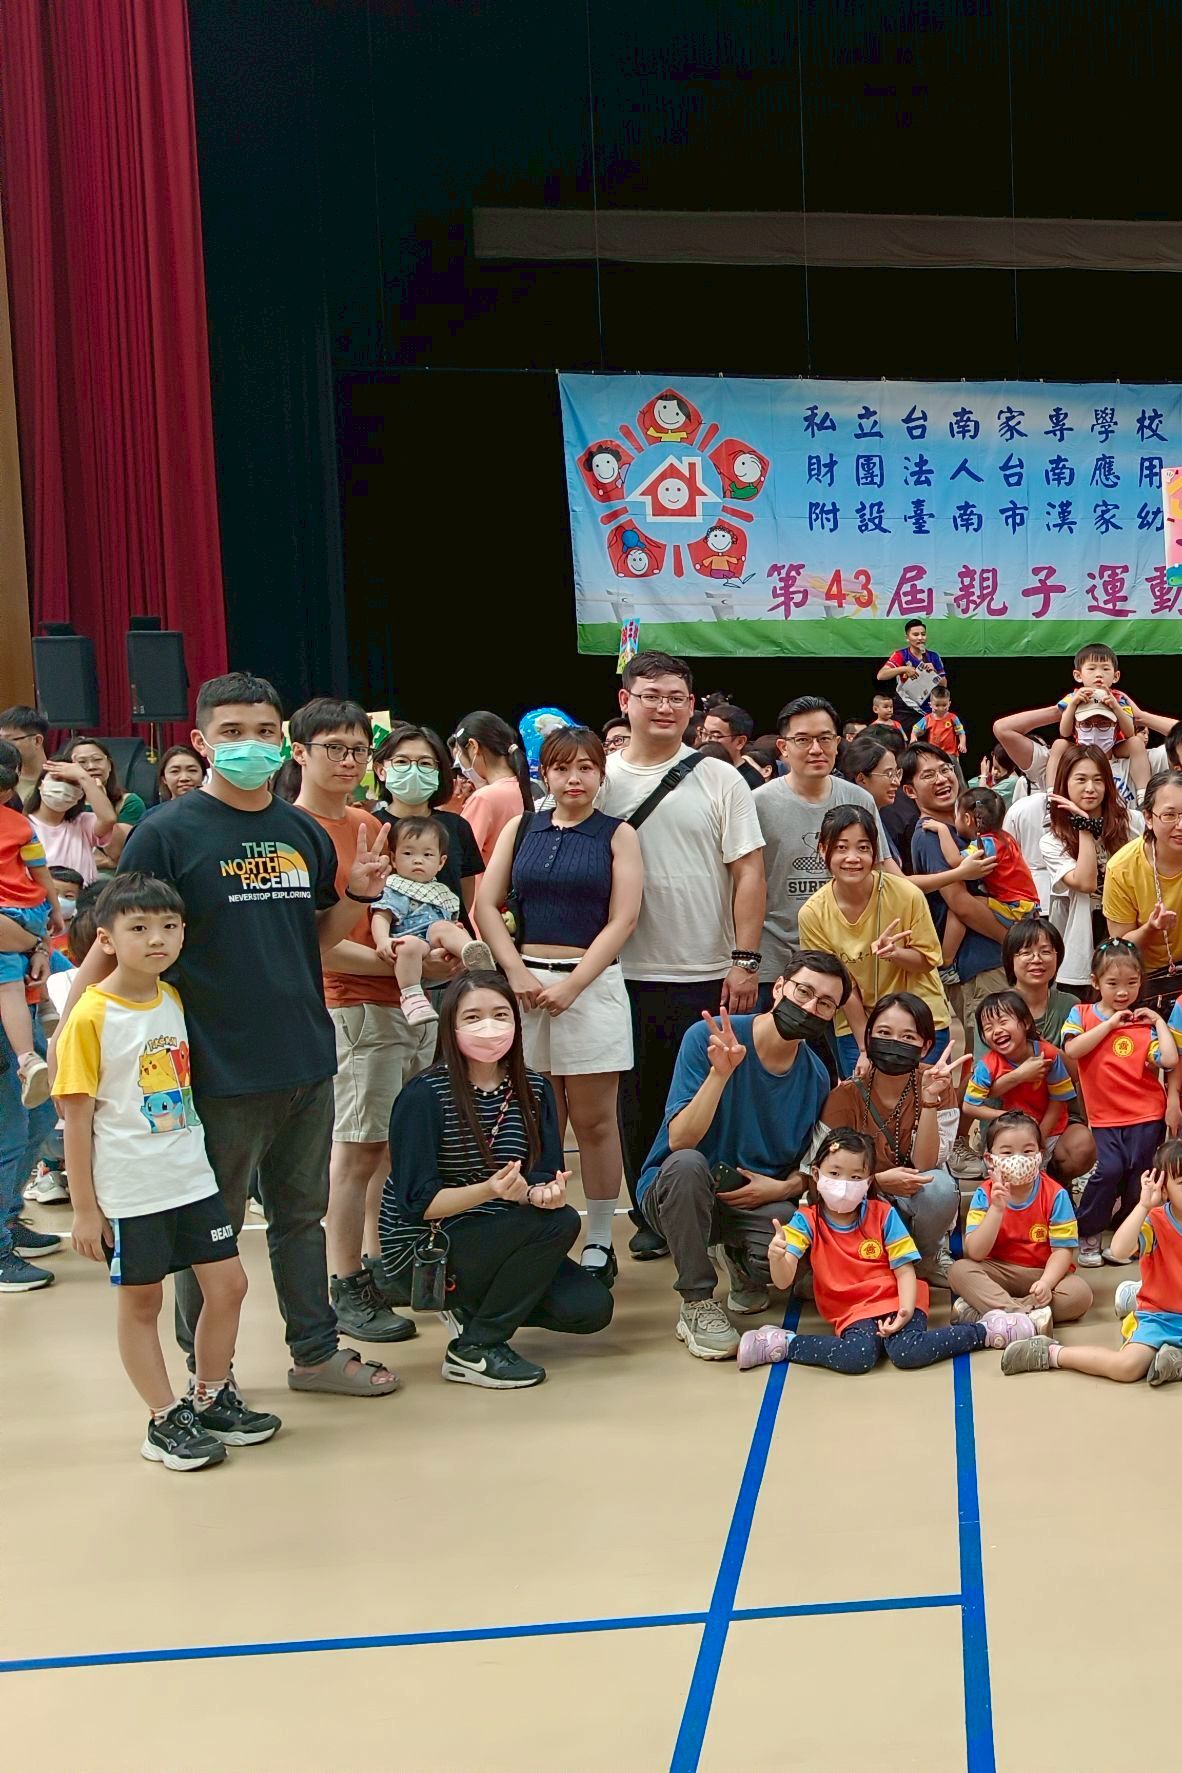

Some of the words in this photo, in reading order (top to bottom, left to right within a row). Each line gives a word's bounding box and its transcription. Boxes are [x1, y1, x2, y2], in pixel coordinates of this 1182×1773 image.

[803, 404, 1168, 443] 私立台南家專學校
[241, 841, 277, 858] THE
[220, 857, 280, 877] NORTH
[240, 872, 282, 890] FACE
[272, 891, 311, 899] EXPLORING
